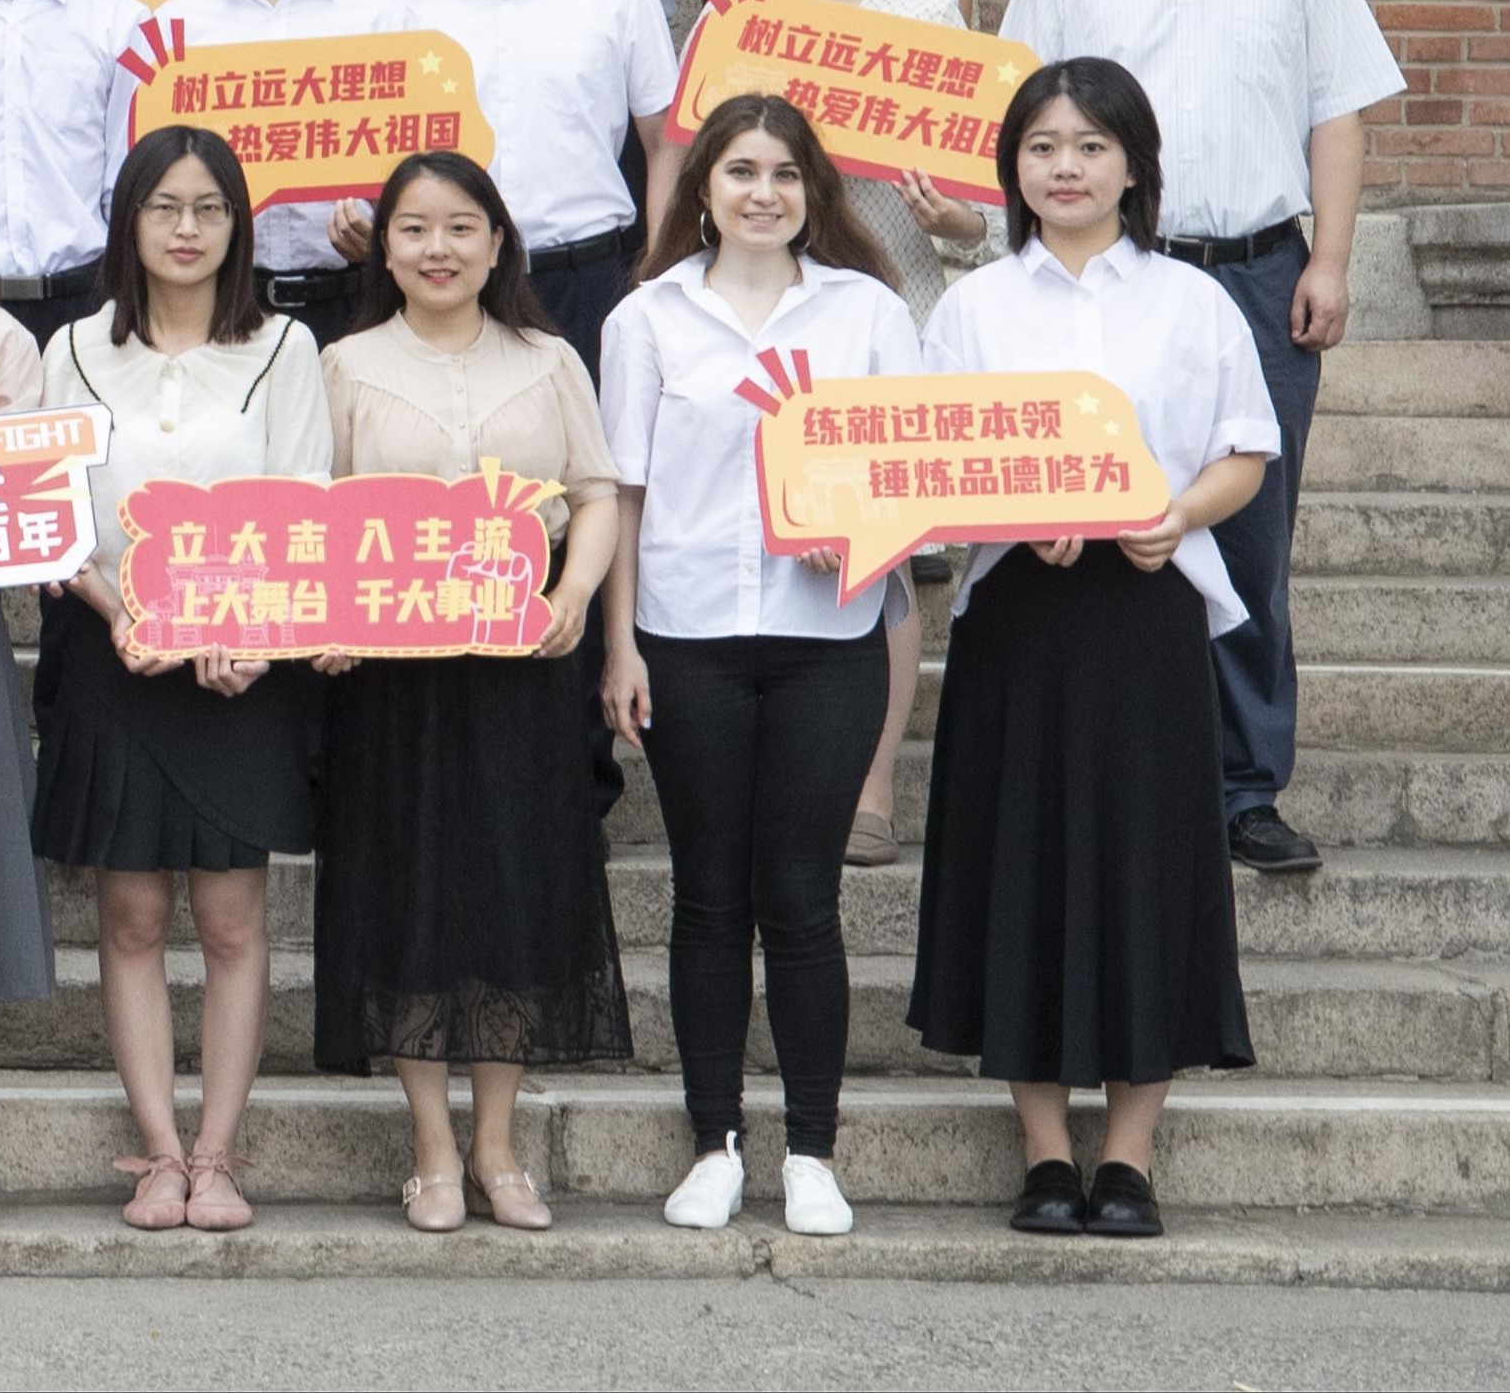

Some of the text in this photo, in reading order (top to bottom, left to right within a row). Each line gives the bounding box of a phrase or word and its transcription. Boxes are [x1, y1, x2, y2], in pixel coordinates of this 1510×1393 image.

[737, 14, 984, 99] 树立远大理想
[171, 60, 407, 114] 树立远大理想
[227, 111, 461, 164] 热爱伟大祖国
[803, 400, 1062, 447] 练就过硬本领
[868, 453, 1131, 500] 锤炼品德修为
[170, 578, 329, 627] 上大舞台
